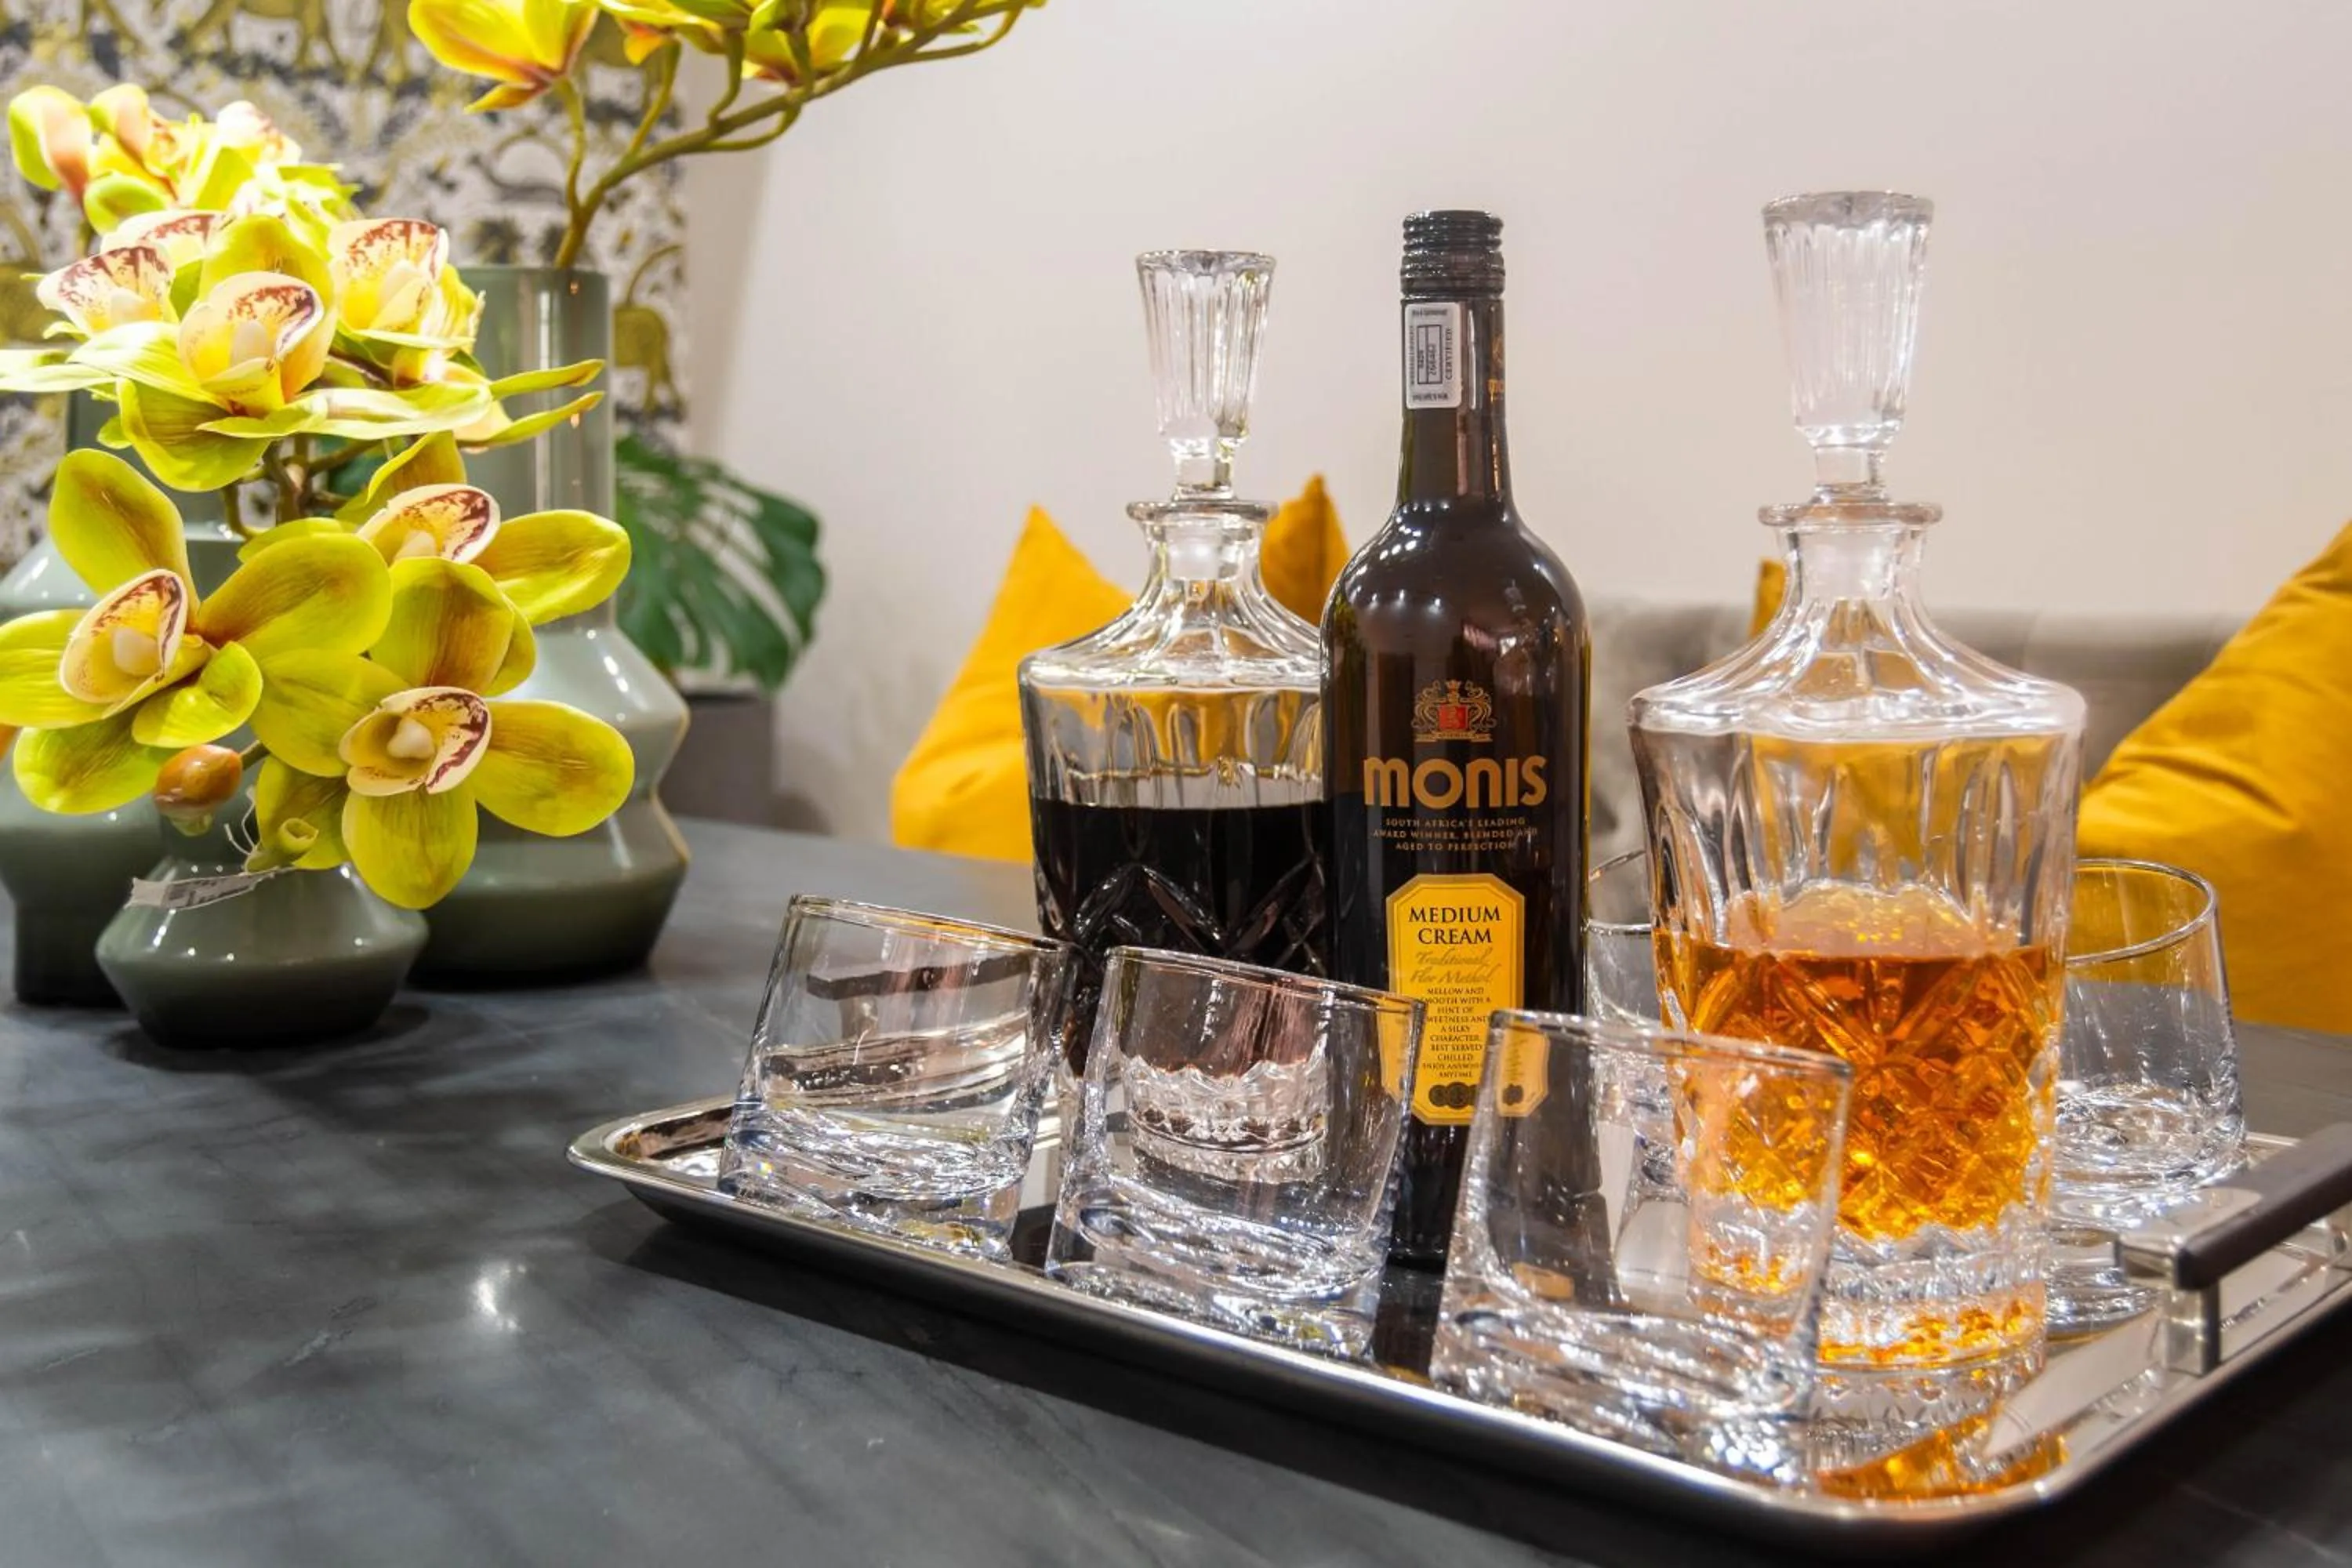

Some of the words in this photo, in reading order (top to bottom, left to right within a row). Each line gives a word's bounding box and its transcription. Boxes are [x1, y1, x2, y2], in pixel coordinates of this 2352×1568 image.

[1386, 818, 1420, 828] SOUTH
[1425, 818, 1473, 828] AFRICA'S
[1477, 817, 1526, 827] LEADING
[1373, 829, 1406, 839] AWARD
[1463, 829, 1514, 840] BLENDED
[1517, 827, 1538, 837] AND
[1396, 842, 1422, 851] AGED
[1428, 842, 1443, 851] TO
[1447, 840, 1515, 851] PERFECTION
[1409, 906, 1502, 923] MEDIUM
[1417, 927, 1492, 945] CREAM
